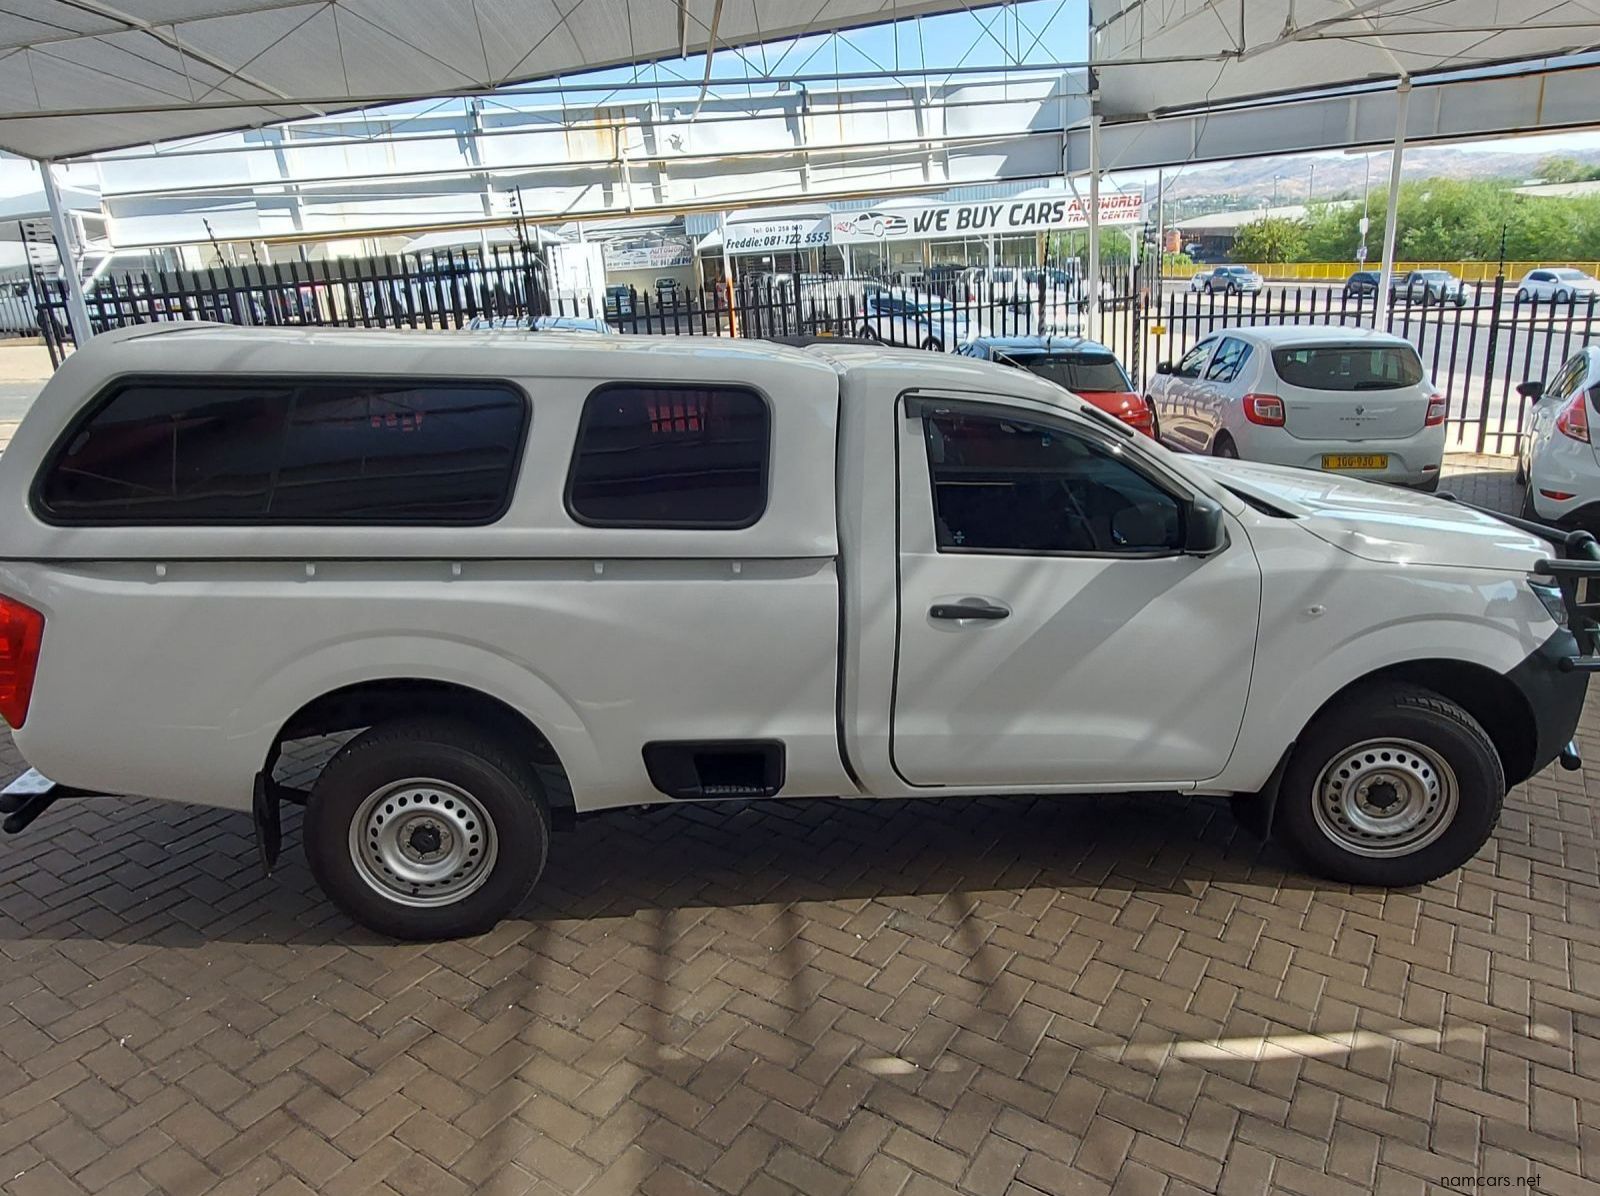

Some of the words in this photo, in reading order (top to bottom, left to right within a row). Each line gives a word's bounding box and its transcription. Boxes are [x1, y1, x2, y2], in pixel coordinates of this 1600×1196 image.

[914, 209, 950, 233] WE
[956, 204, 1005, 230] BUY
[1009, 200, 1066, 226] CARS
[1101, 209, 1141, 220] CENTRE
[726, 236, 763, 249] Freddie:
[805, 232, 830, 243] 5555
